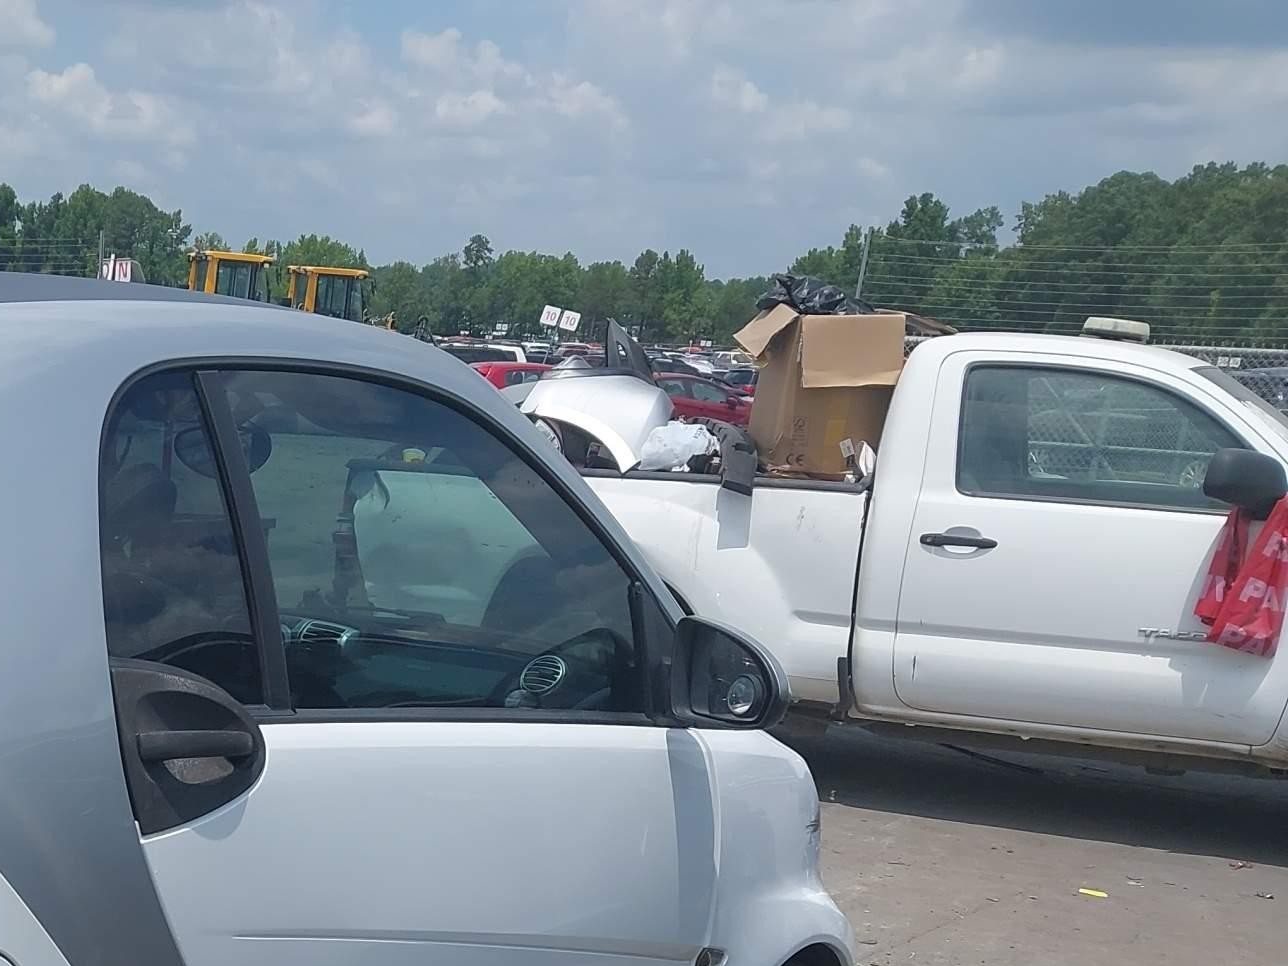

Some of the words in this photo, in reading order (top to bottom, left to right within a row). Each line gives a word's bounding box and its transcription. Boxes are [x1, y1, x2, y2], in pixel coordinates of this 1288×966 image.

[118, 262, 128, 278] N
[545, 310, 557, 322] 10
[565, 316, 577, 327] 10
